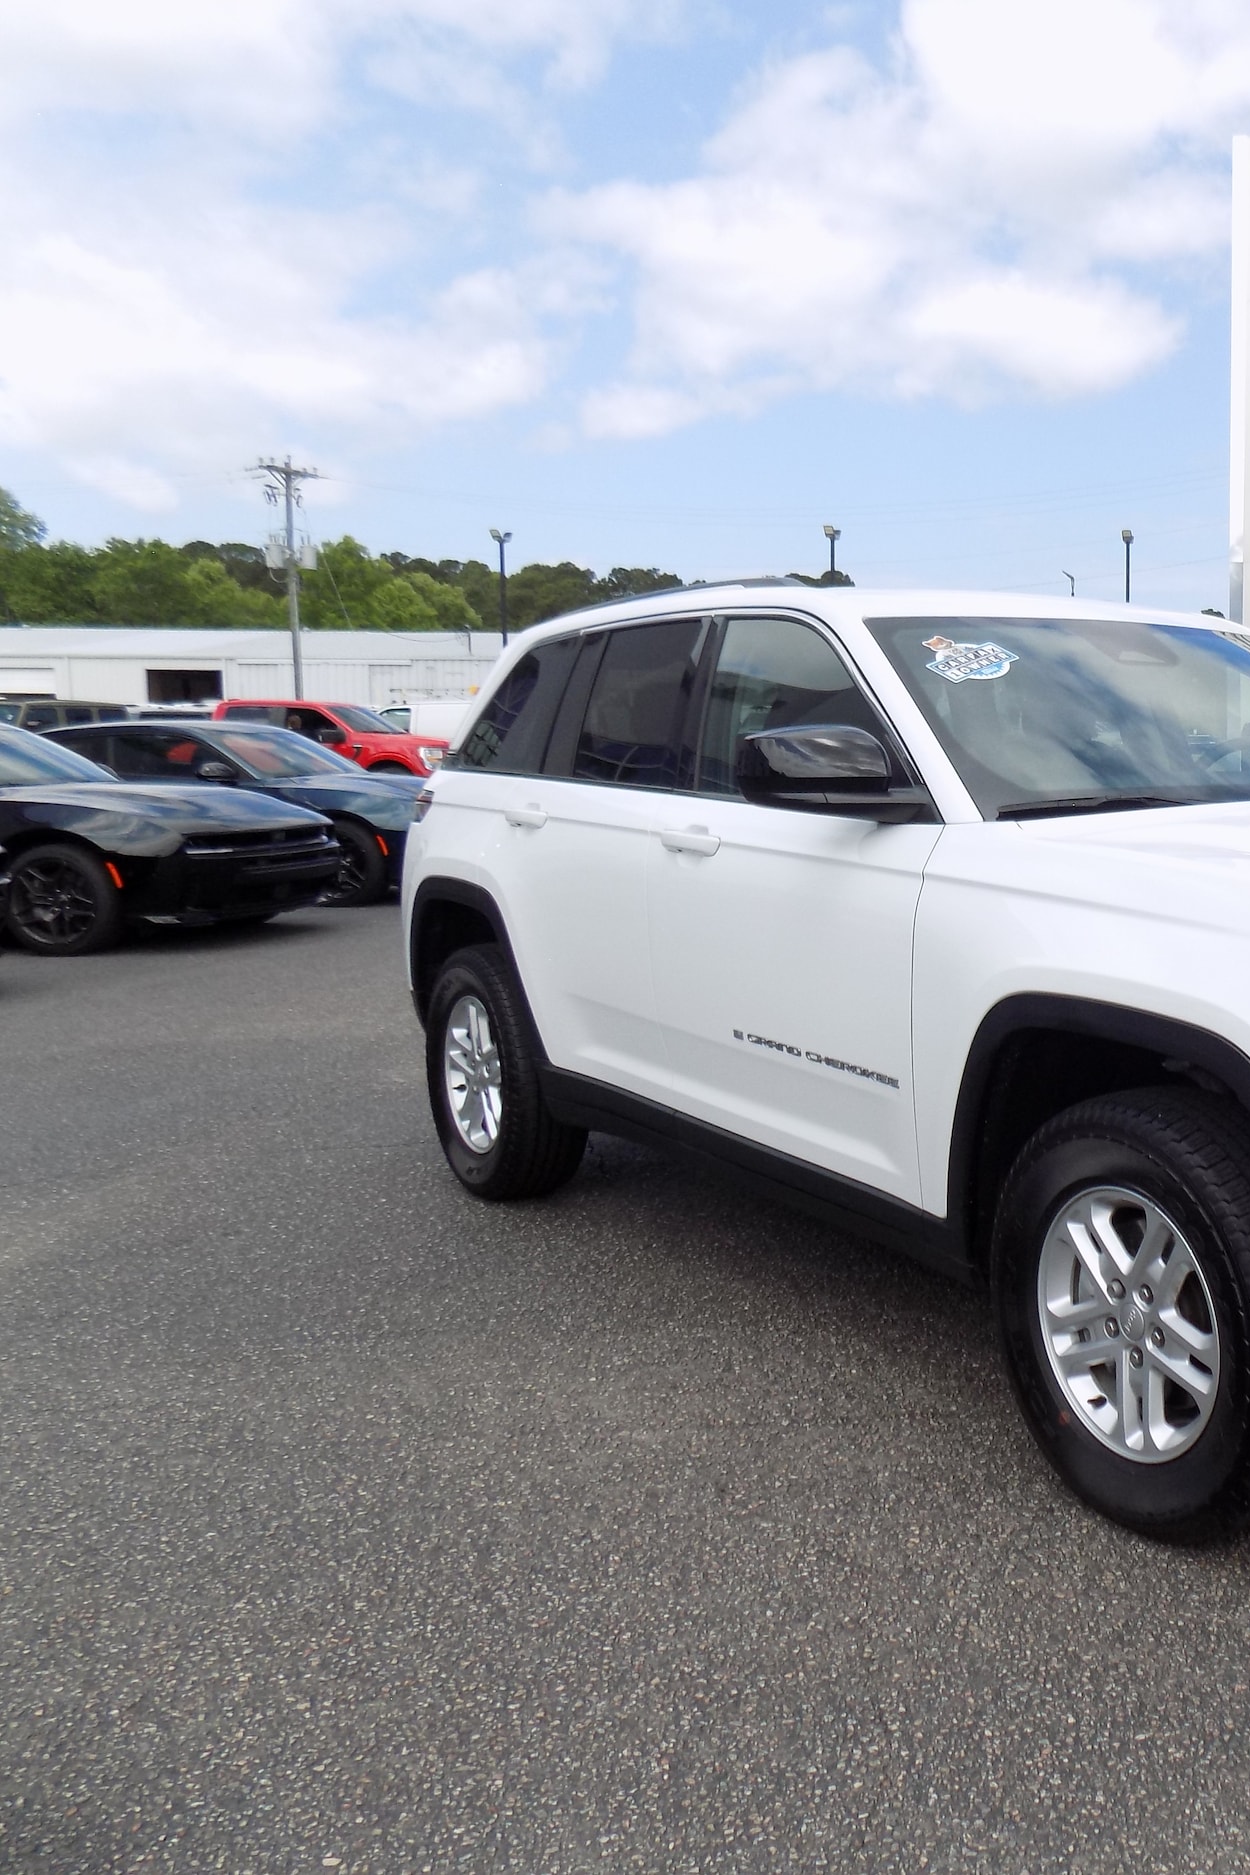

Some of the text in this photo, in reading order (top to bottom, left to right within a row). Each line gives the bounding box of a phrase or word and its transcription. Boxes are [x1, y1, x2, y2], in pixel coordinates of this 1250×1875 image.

[937, 648, 1000, 671] CARFAX
[747, 1033, 900, 1089] GRAND CHEROKEE
